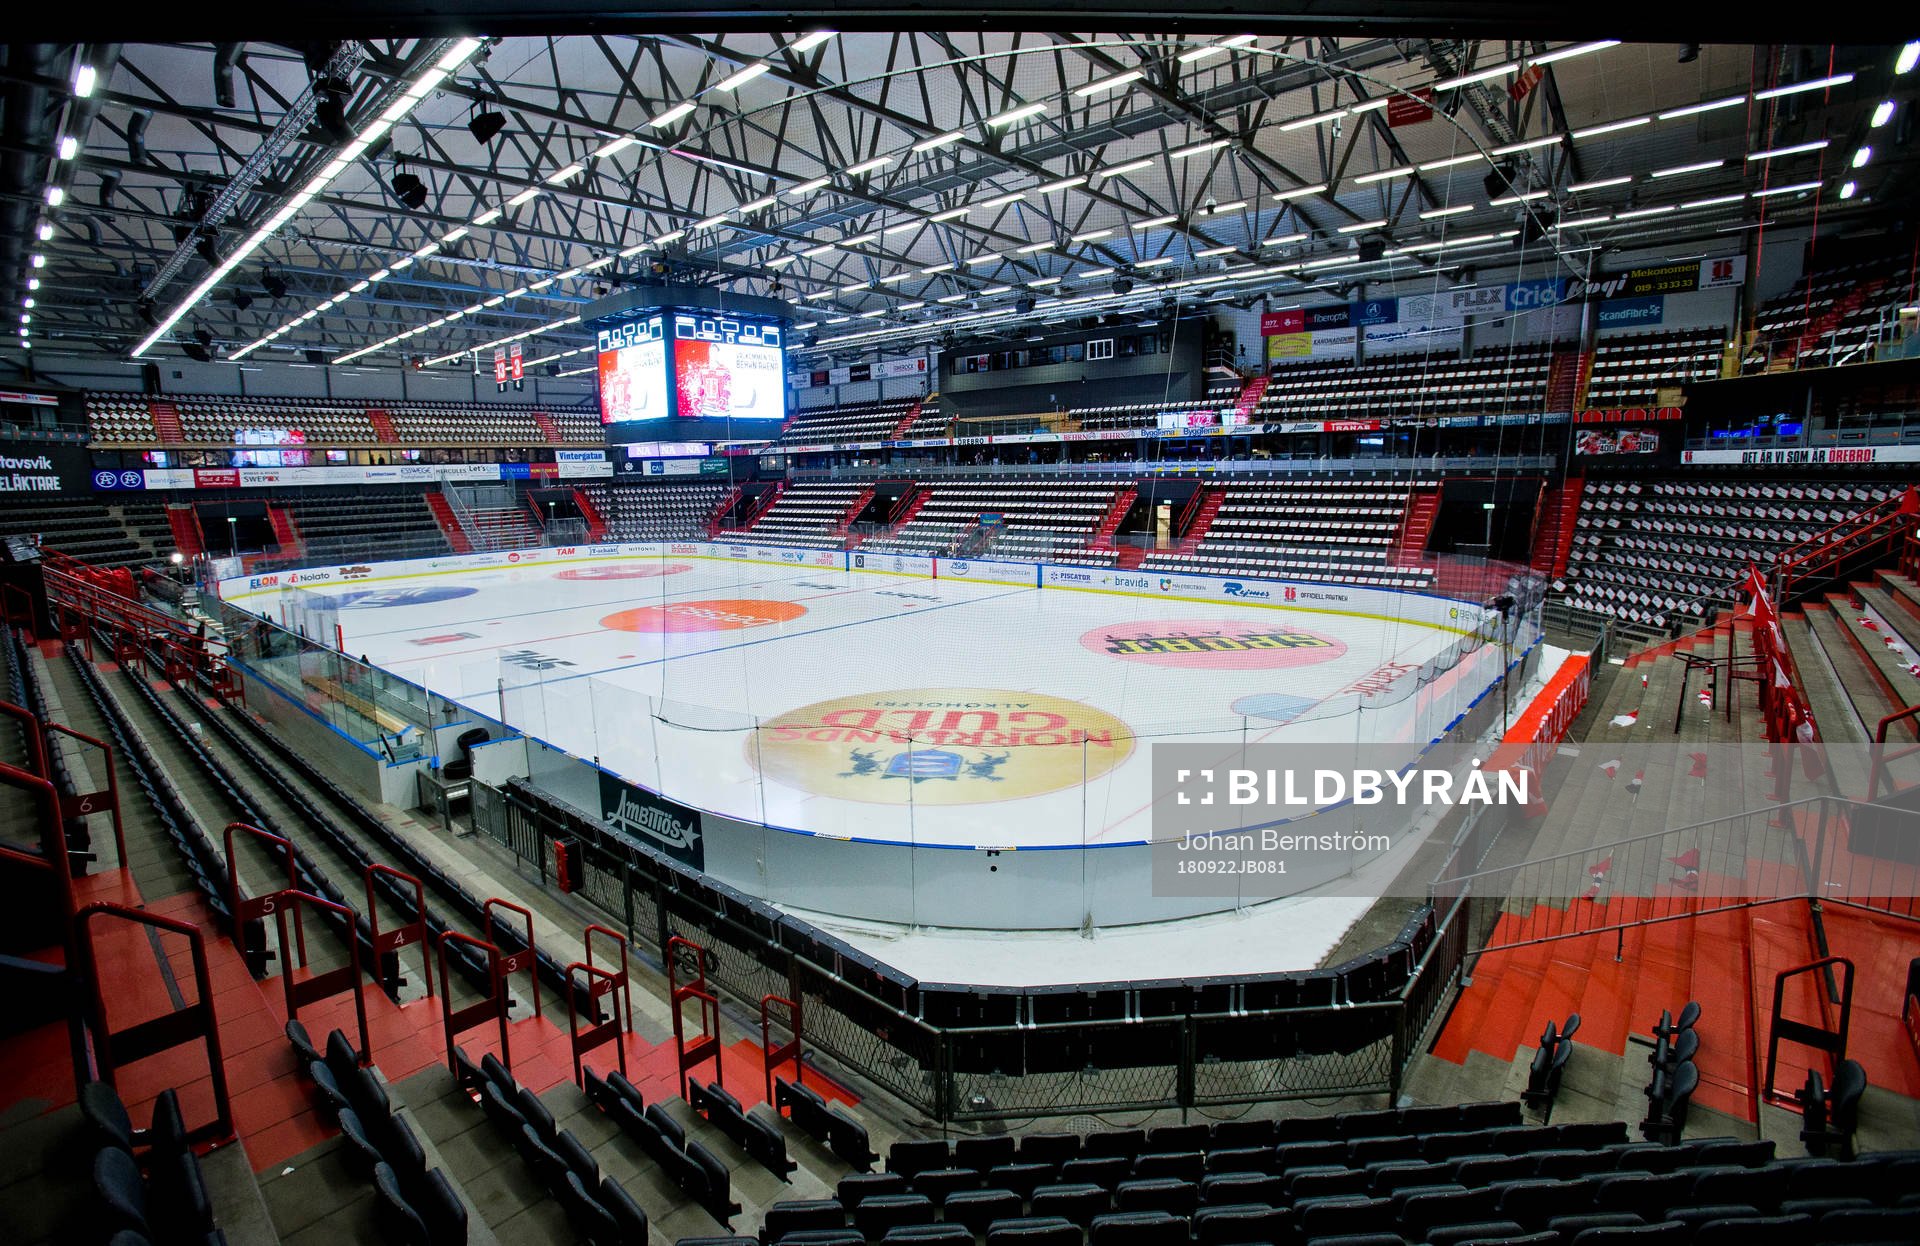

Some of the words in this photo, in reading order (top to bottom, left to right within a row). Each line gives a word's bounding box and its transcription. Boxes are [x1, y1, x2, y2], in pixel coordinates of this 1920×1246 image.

[1630, 264, 1700, 278] Mekonomen
[1453, 289, 1502, 308] FLEX
[1742, 452, 1756, 464] DET
[1760, 449, 1772, 463] ÄR
[1776, 451, 1784, 463] VI
[1787, 450, 1808, 463] SOM
[1812, 448, 1826, 463] ÄR
[1829, 448, 1876, 462] ÖREBRO!
[556, 548, 576, 556] TAM
[250, 576, 278, 588] ELON
[300, 572, 330, 582] Nolato
[1060, 573, 1091, 581] PISCATOR
[1115, 576, 1148, 588] bravida
[1301, 592, 1324, 600] OFFICIELL
[1106, 632, 1334, 655] SPORT
[820, 709, 1068, 732] GULD
[766, 724, 1114, 749] NORRLANDS
[80, 797, 92, 812] 6
[263, 896, 275, 912] 5
[394, 931, 406, 945] 4
[508, 958, 517, 972] 3
[604, 979, 612, 992] 2
